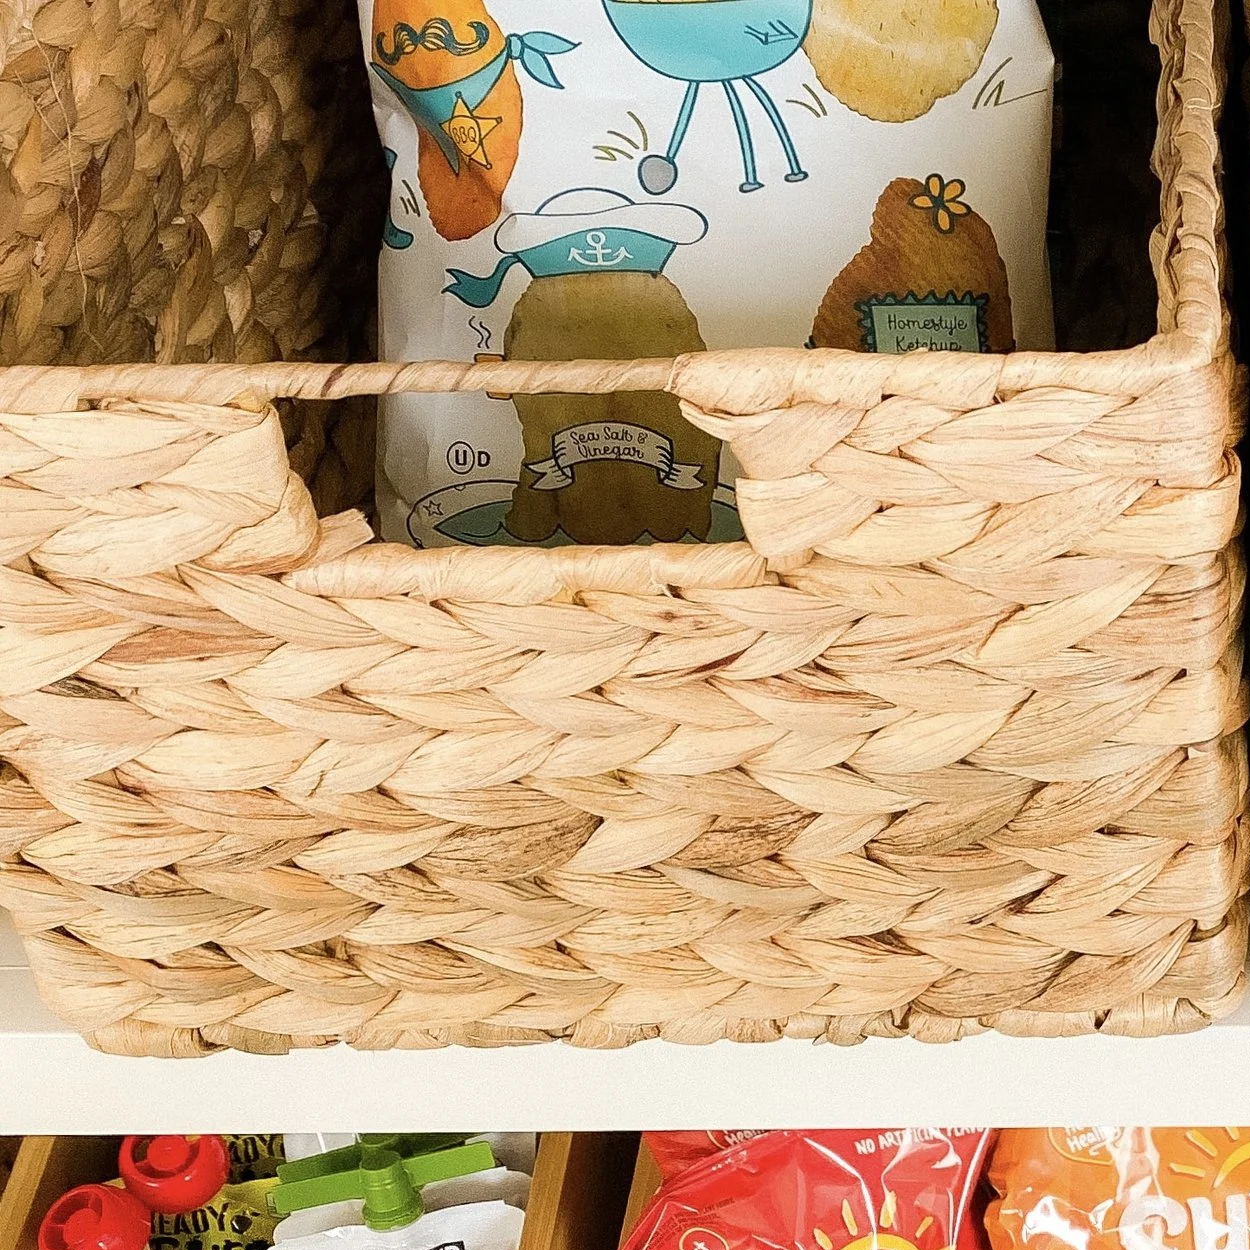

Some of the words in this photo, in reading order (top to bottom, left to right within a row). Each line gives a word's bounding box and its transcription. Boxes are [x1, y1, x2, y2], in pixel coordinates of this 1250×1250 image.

[452, 126, 478, 144] BBQ
[887, 314, 968, 335] Homestyle
[570, 431, 599, 446] Sea
[603, 426, 633, 441] Salt
[577, 443, 645, 459] Vinegar
[854, 1139, 876, 1155] NO
